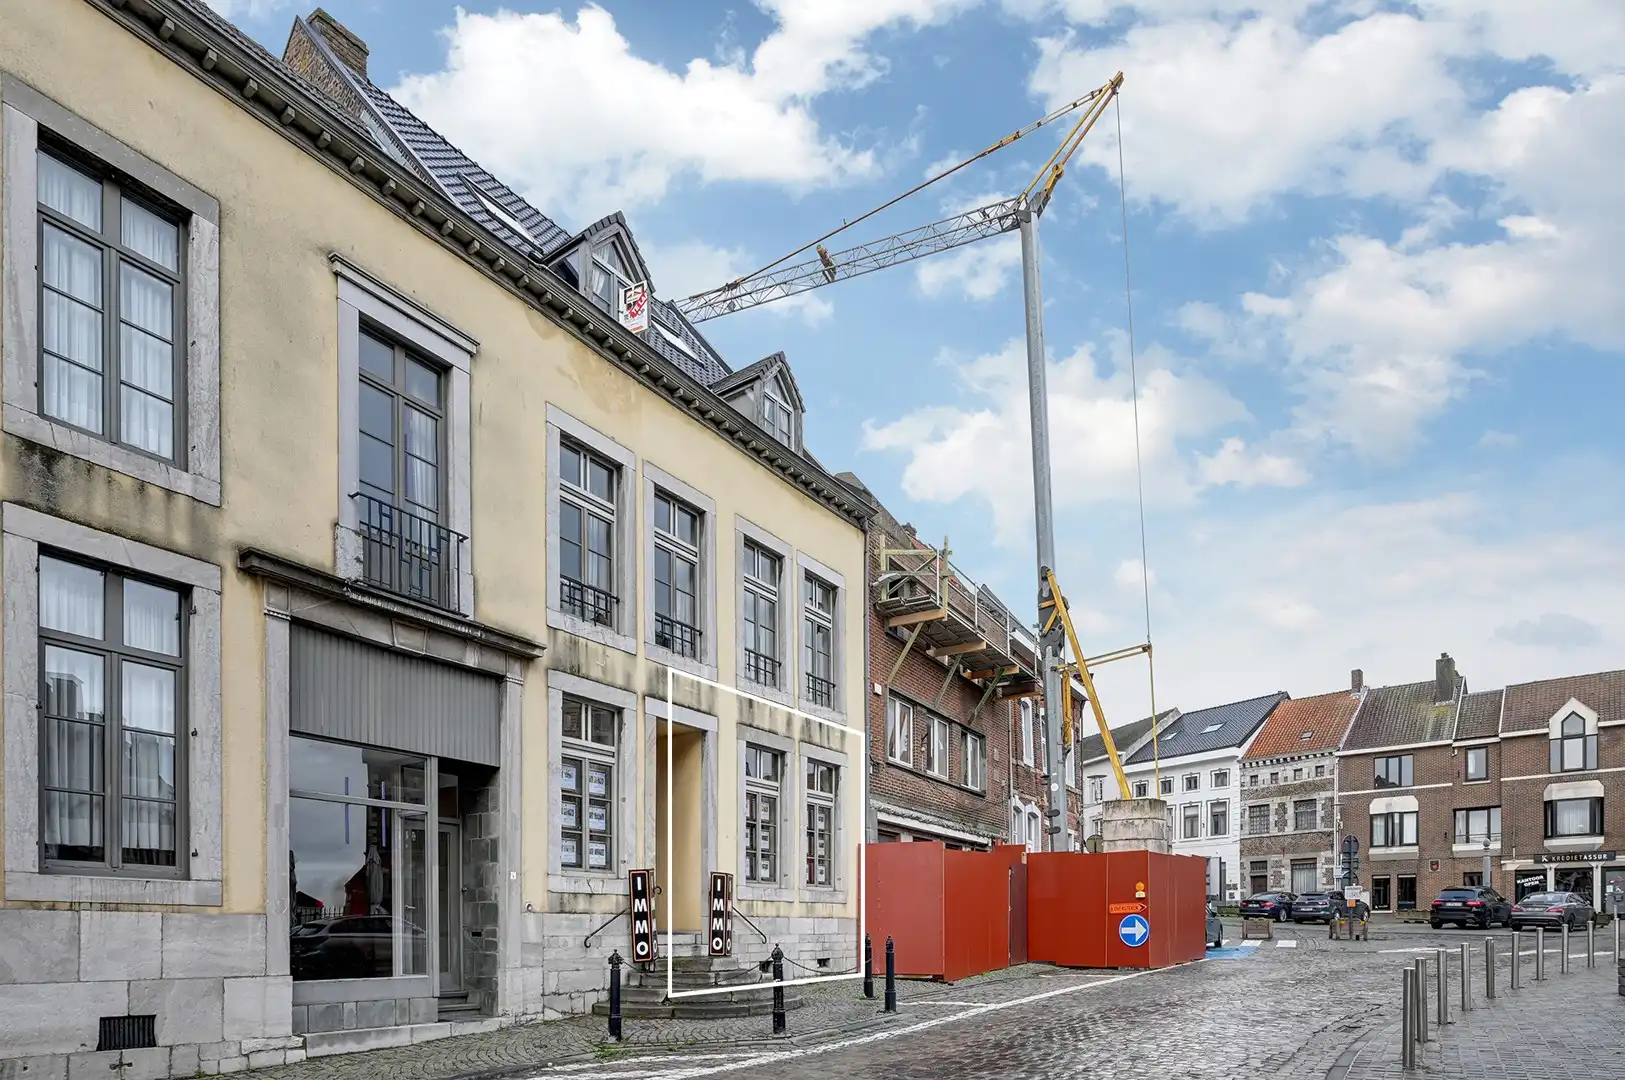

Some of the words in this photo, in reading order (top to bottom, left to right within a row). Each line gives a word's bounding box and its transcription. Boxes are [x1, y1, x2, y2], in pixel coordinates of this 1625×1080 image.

[634, 876, 649, 956] IMMO
[712, 878, 724, 951] IMMO
[1517, 875, 1544, 884] KANTOOR
